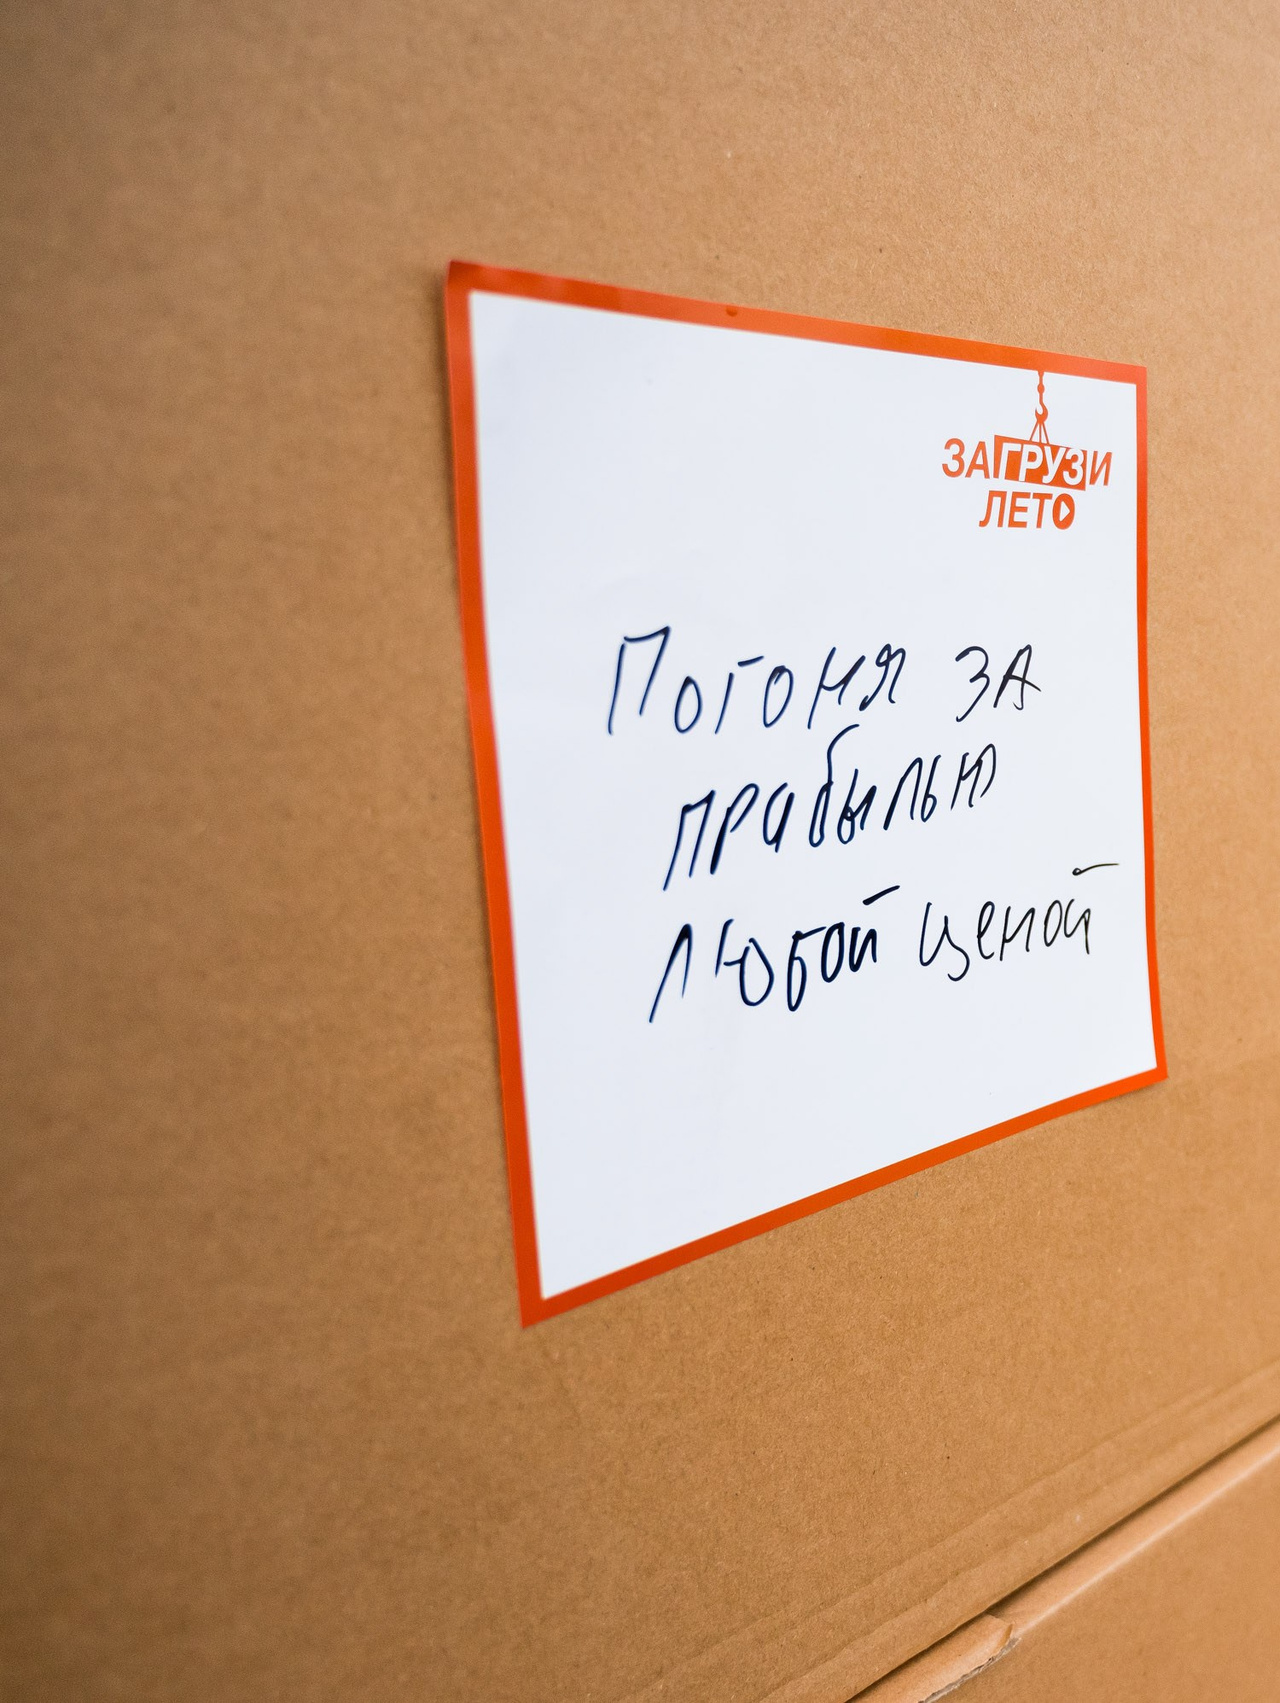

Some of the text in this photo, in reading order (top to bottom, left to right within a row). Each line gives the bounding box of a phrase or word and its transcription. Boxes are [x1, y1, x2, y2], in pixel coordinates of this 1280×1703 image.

[941, 435, 1113, 491] ЗАГРУЗИ
[978, 490, 1076, 530] ЛЕТО
[607, 625, 907, 736] Погоня
